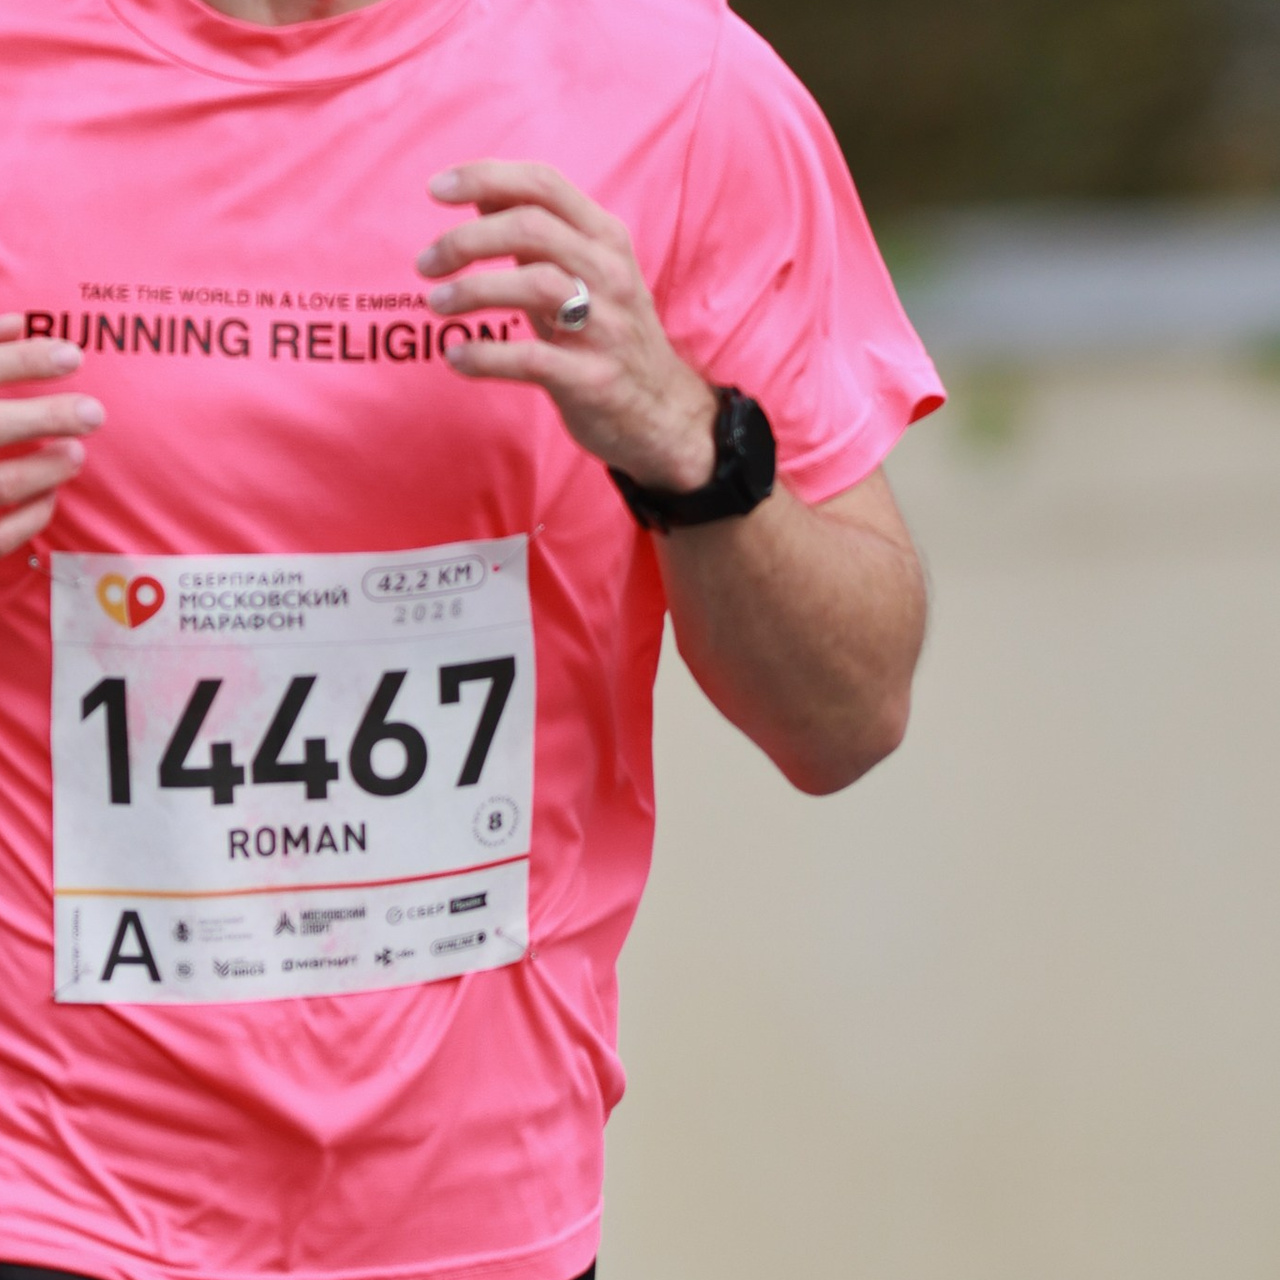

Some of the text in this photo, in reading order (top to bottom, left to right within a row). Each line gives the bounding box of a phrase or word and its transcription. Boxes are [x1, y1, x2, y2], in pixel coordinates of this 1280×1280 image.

[80, 283, 428, 311] TAKE THE WORLD IN A LOVE EMBRA
[25, 312, 250, 358] RUNNING
[178, 569, 303, 588] СБЕРПРАЙМ
[178, 586, 350, 610] МОСКОВСКИЙ
[178, 612, 305, 632] МАРАФОН
[81, 655, 517, 806] 14467
[488, 810, 502, 832] 8
[228, 822, 368, 859] ROMAN
